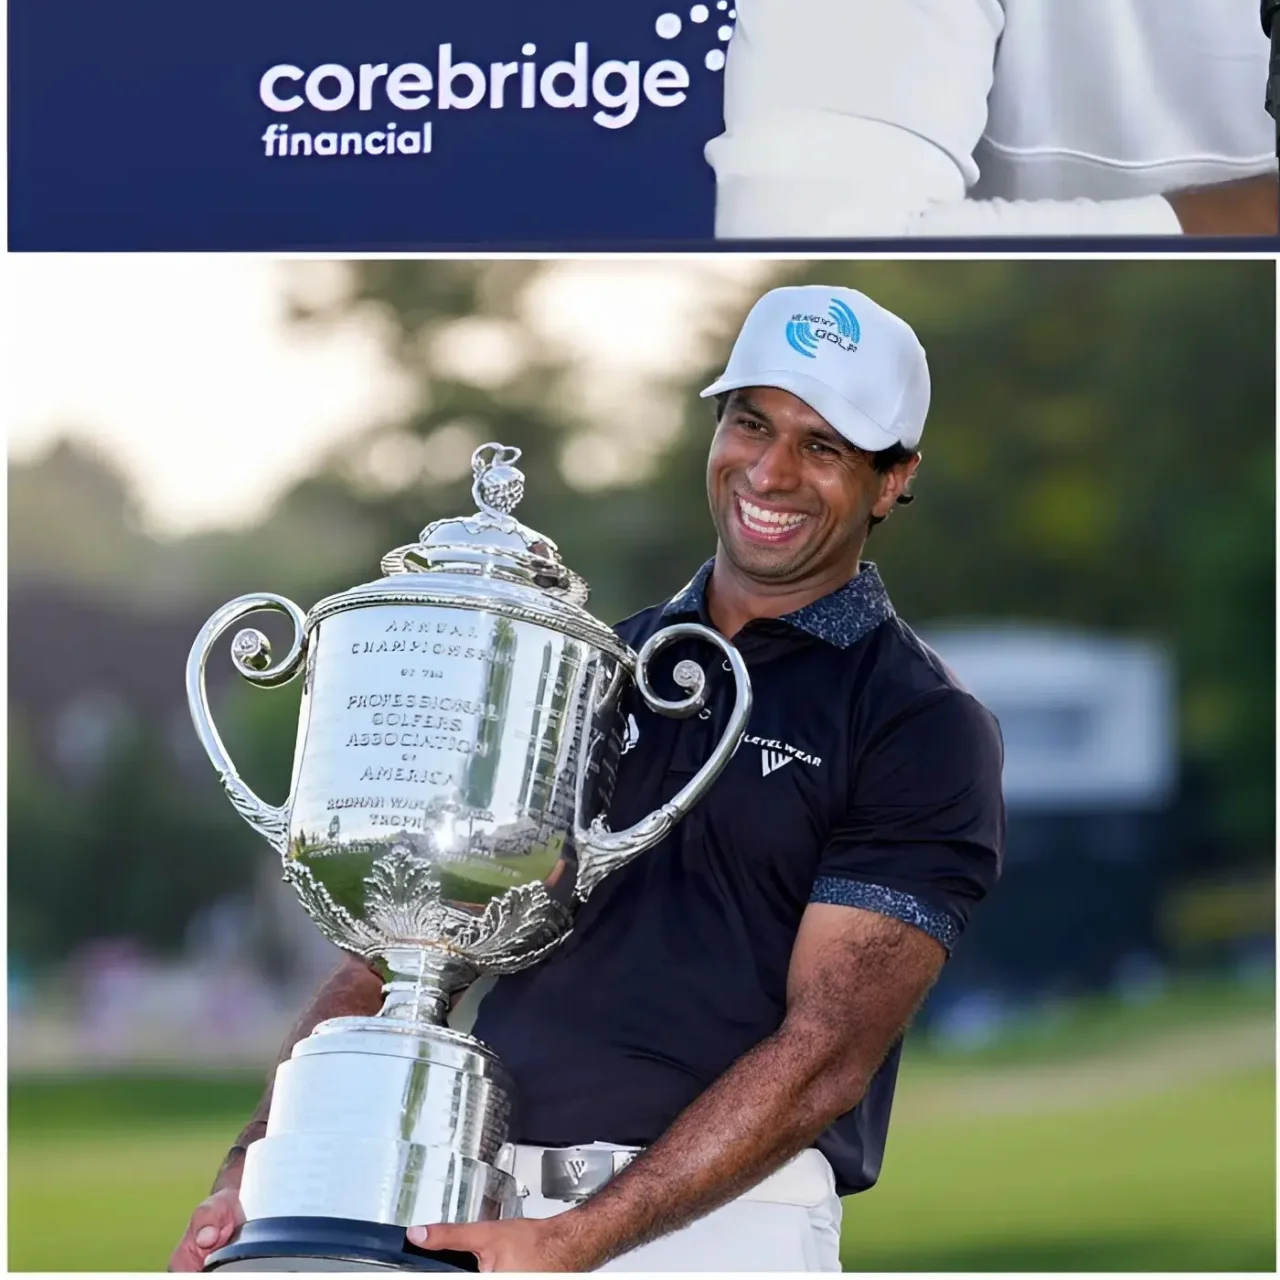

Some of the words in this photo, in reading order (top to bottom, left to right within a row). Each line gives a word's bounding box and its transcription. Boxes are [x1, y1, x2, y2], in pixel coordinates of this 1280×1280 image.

[259, 41, 690, 129] corebridge
[261, 121, 432, 157] financial
[815, 328, 858, 352] GOLF
